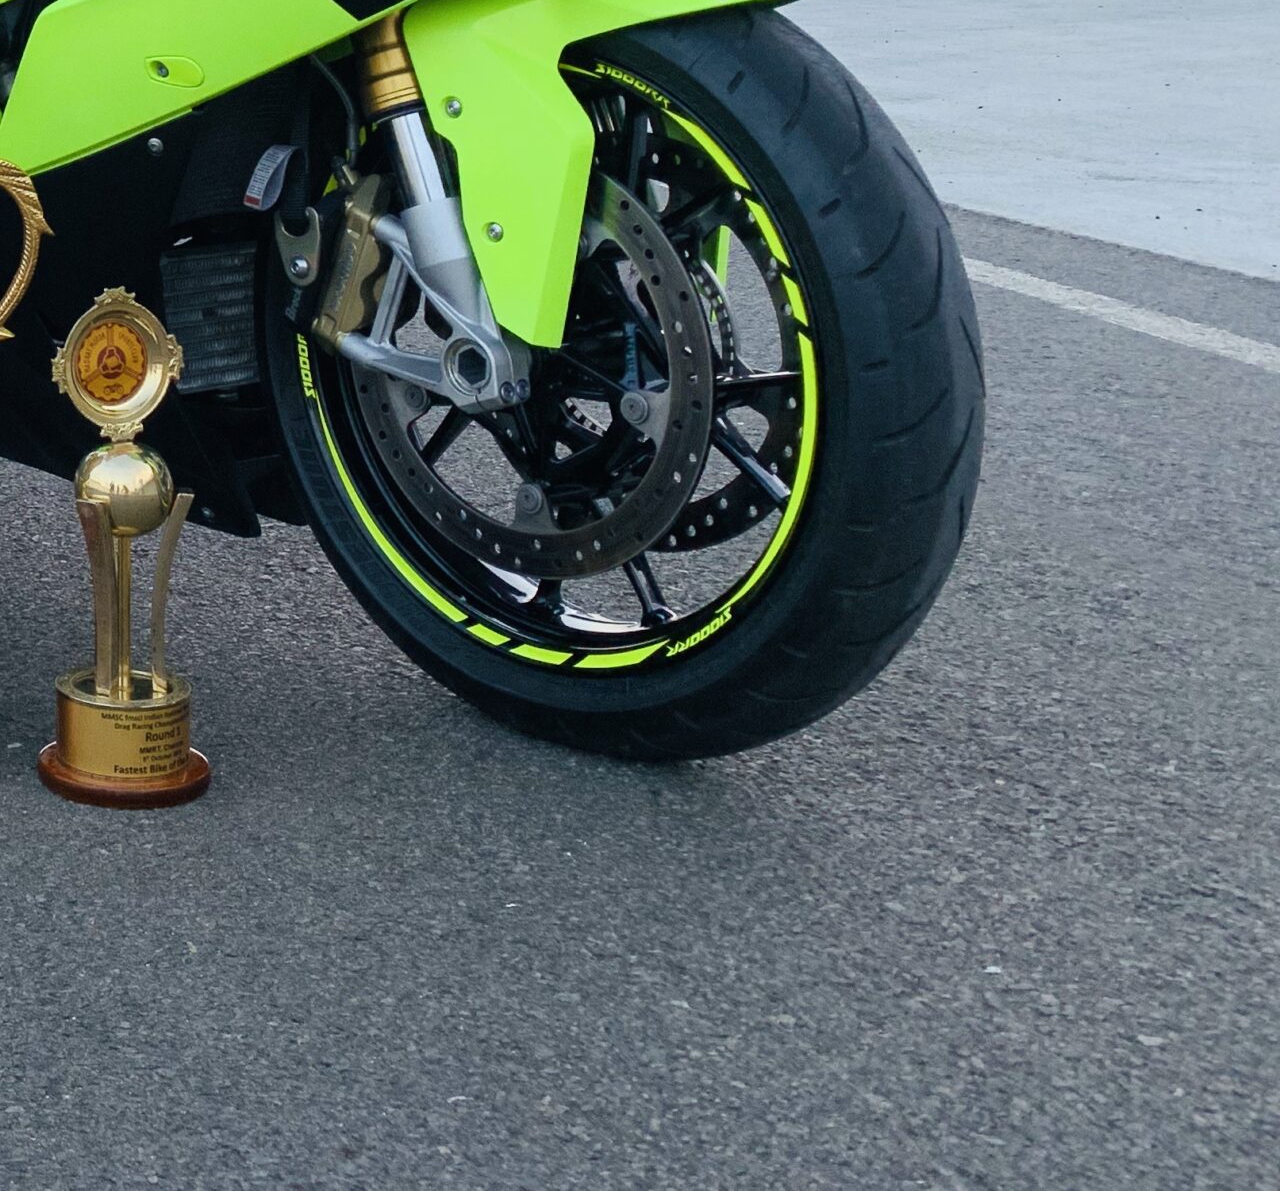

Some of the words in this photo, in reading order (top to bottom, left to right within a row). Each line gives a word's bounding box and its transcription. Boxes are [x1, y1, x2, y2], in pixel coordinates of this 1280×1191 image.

[666, 607, 732, 657] S1000RR
[145, 728, 175, 742] Round
[114, 765, 148, 774] Fastest
[149, 763, 168, 774] Bike
